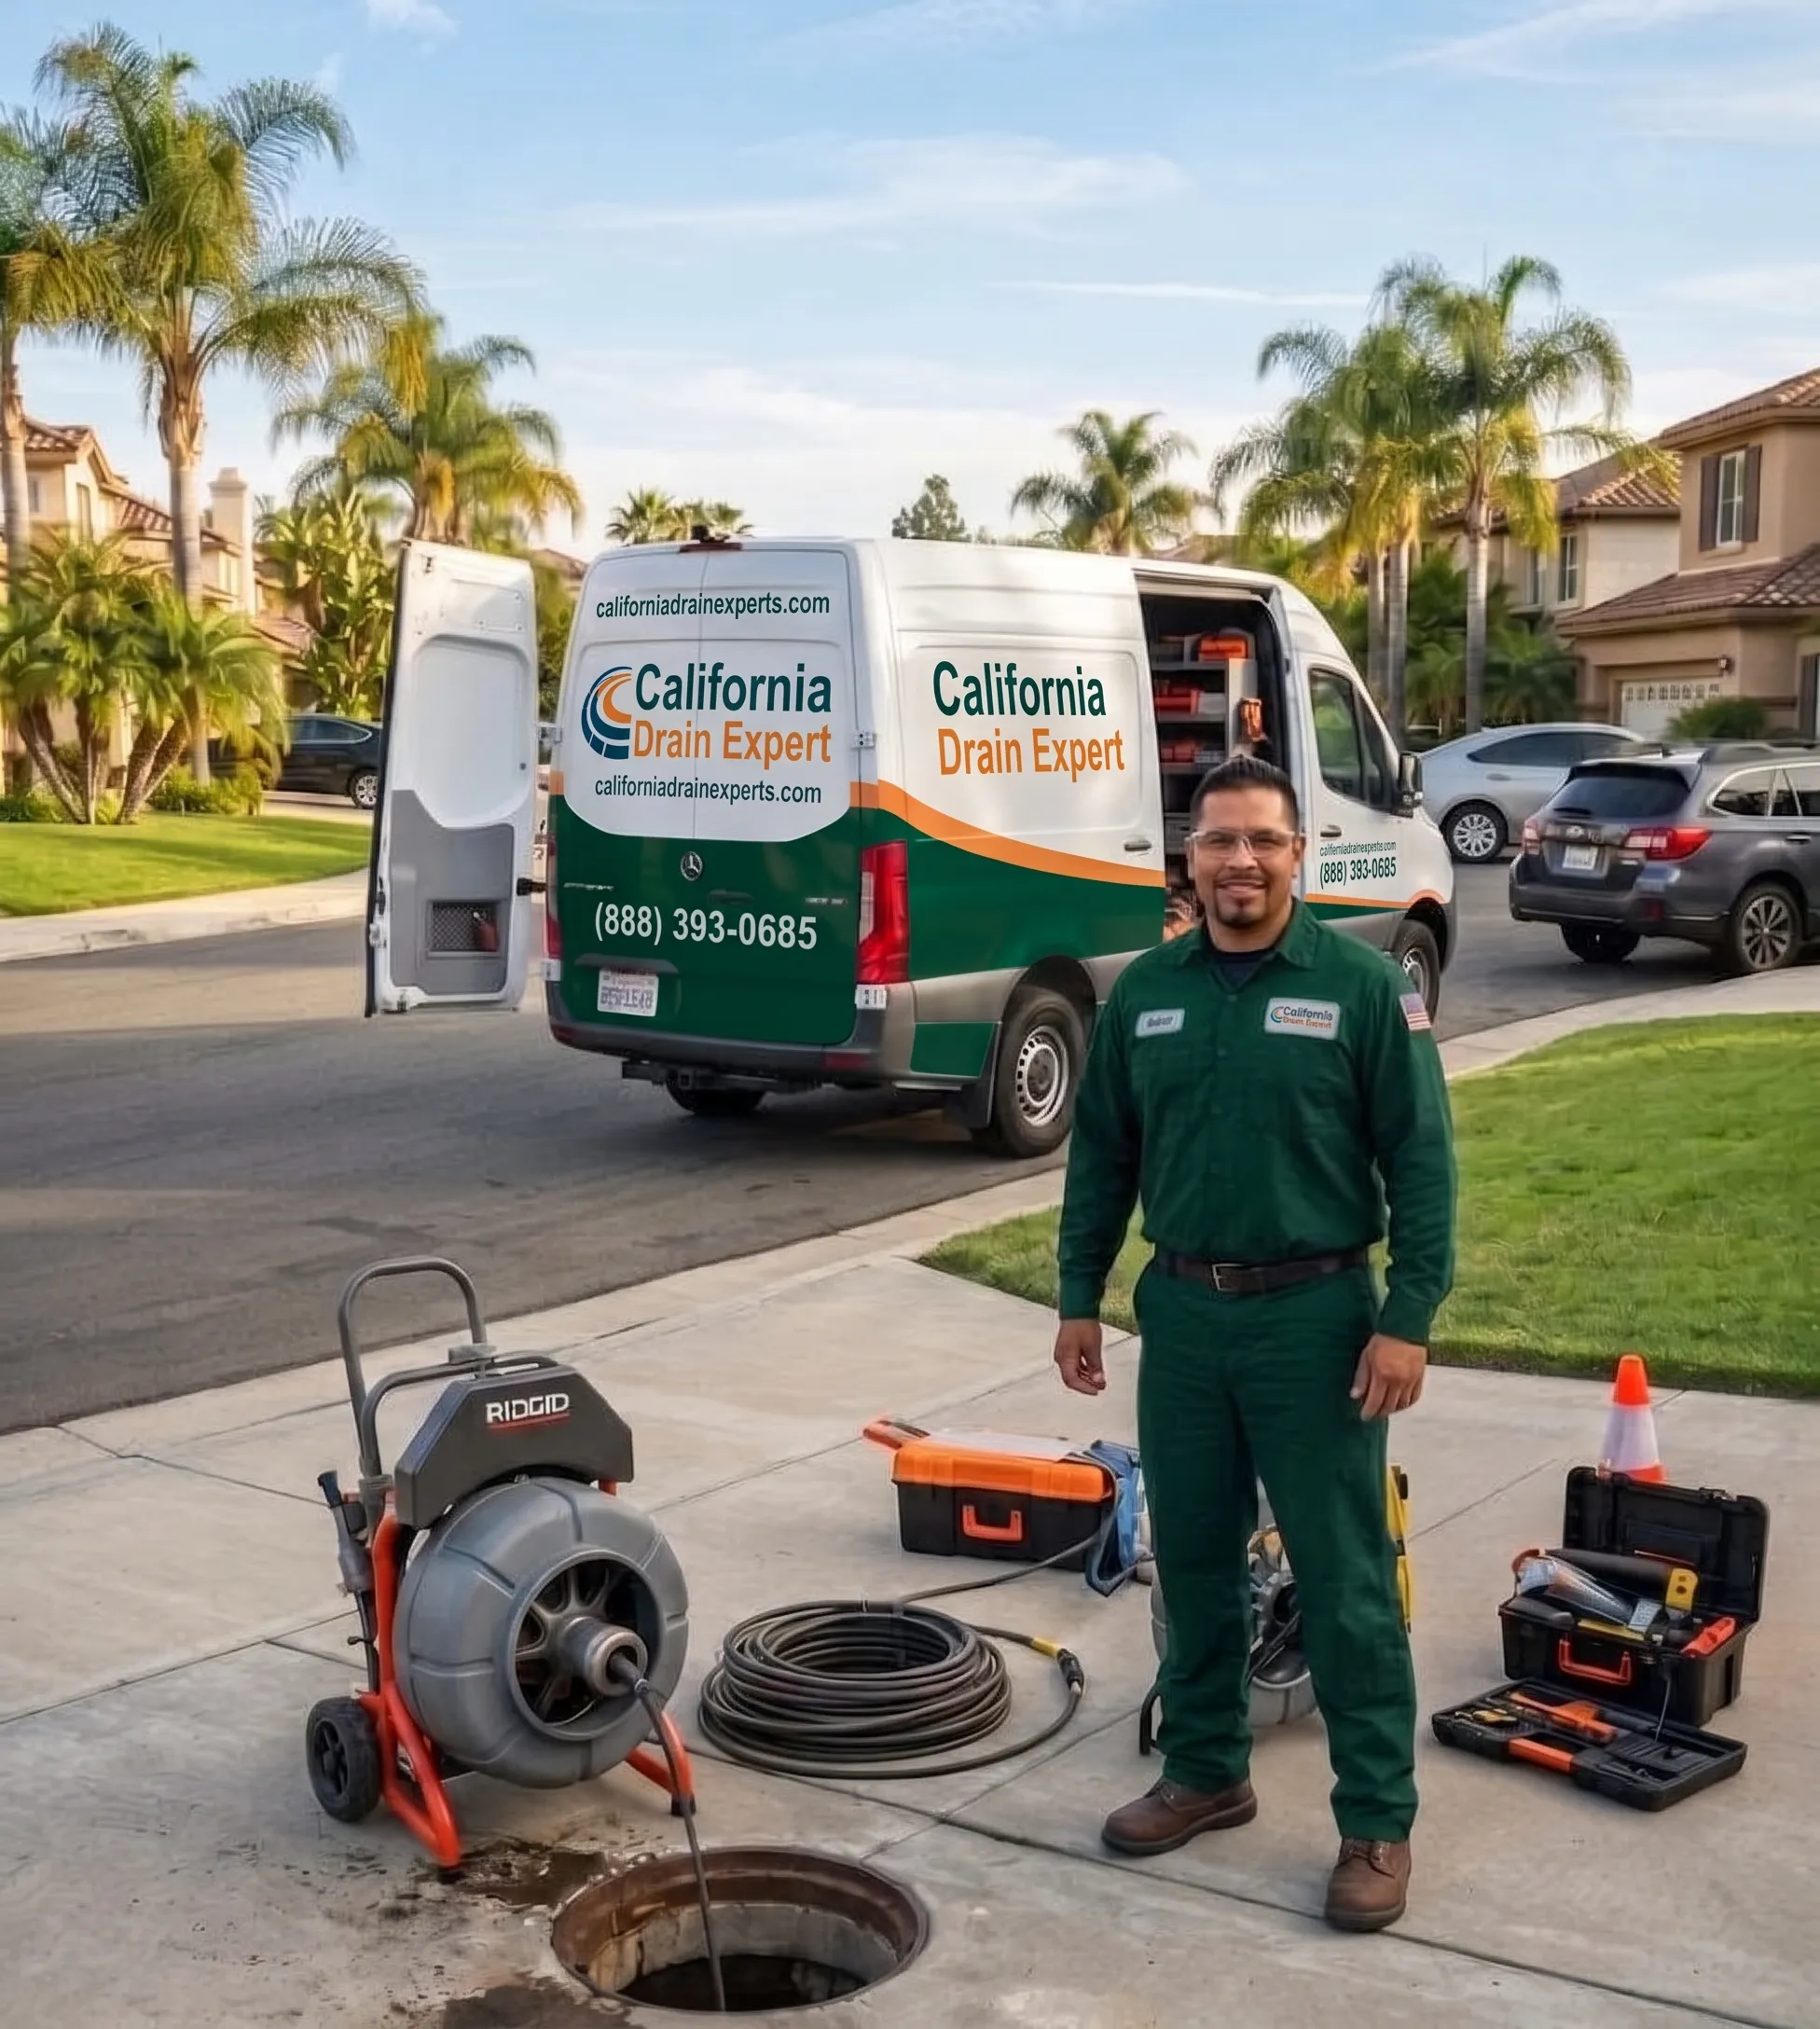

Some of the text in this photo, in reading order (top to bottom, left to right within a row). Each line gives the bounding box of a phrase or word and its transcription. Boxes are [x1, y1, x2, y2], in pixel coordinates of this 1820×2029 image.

[596, 592, 830, 618] californiadrainexperts.com
[635, 662, 832, 712] California
[933, 661, 1107, 716] California
[634, 721, 832, 770] Drain Expert
[938, 728, 1124, 782] Drain Expert
[594, 775, 822, 805] californiadrainexperts.com
[1319, 857, 1396, 889] (888) 393-0685
[595, 902, 817, 949] (888) 393-0685
[1283, 1006, 1333, 1021] California
[486, 1393, 570, 1424] RIDGID
